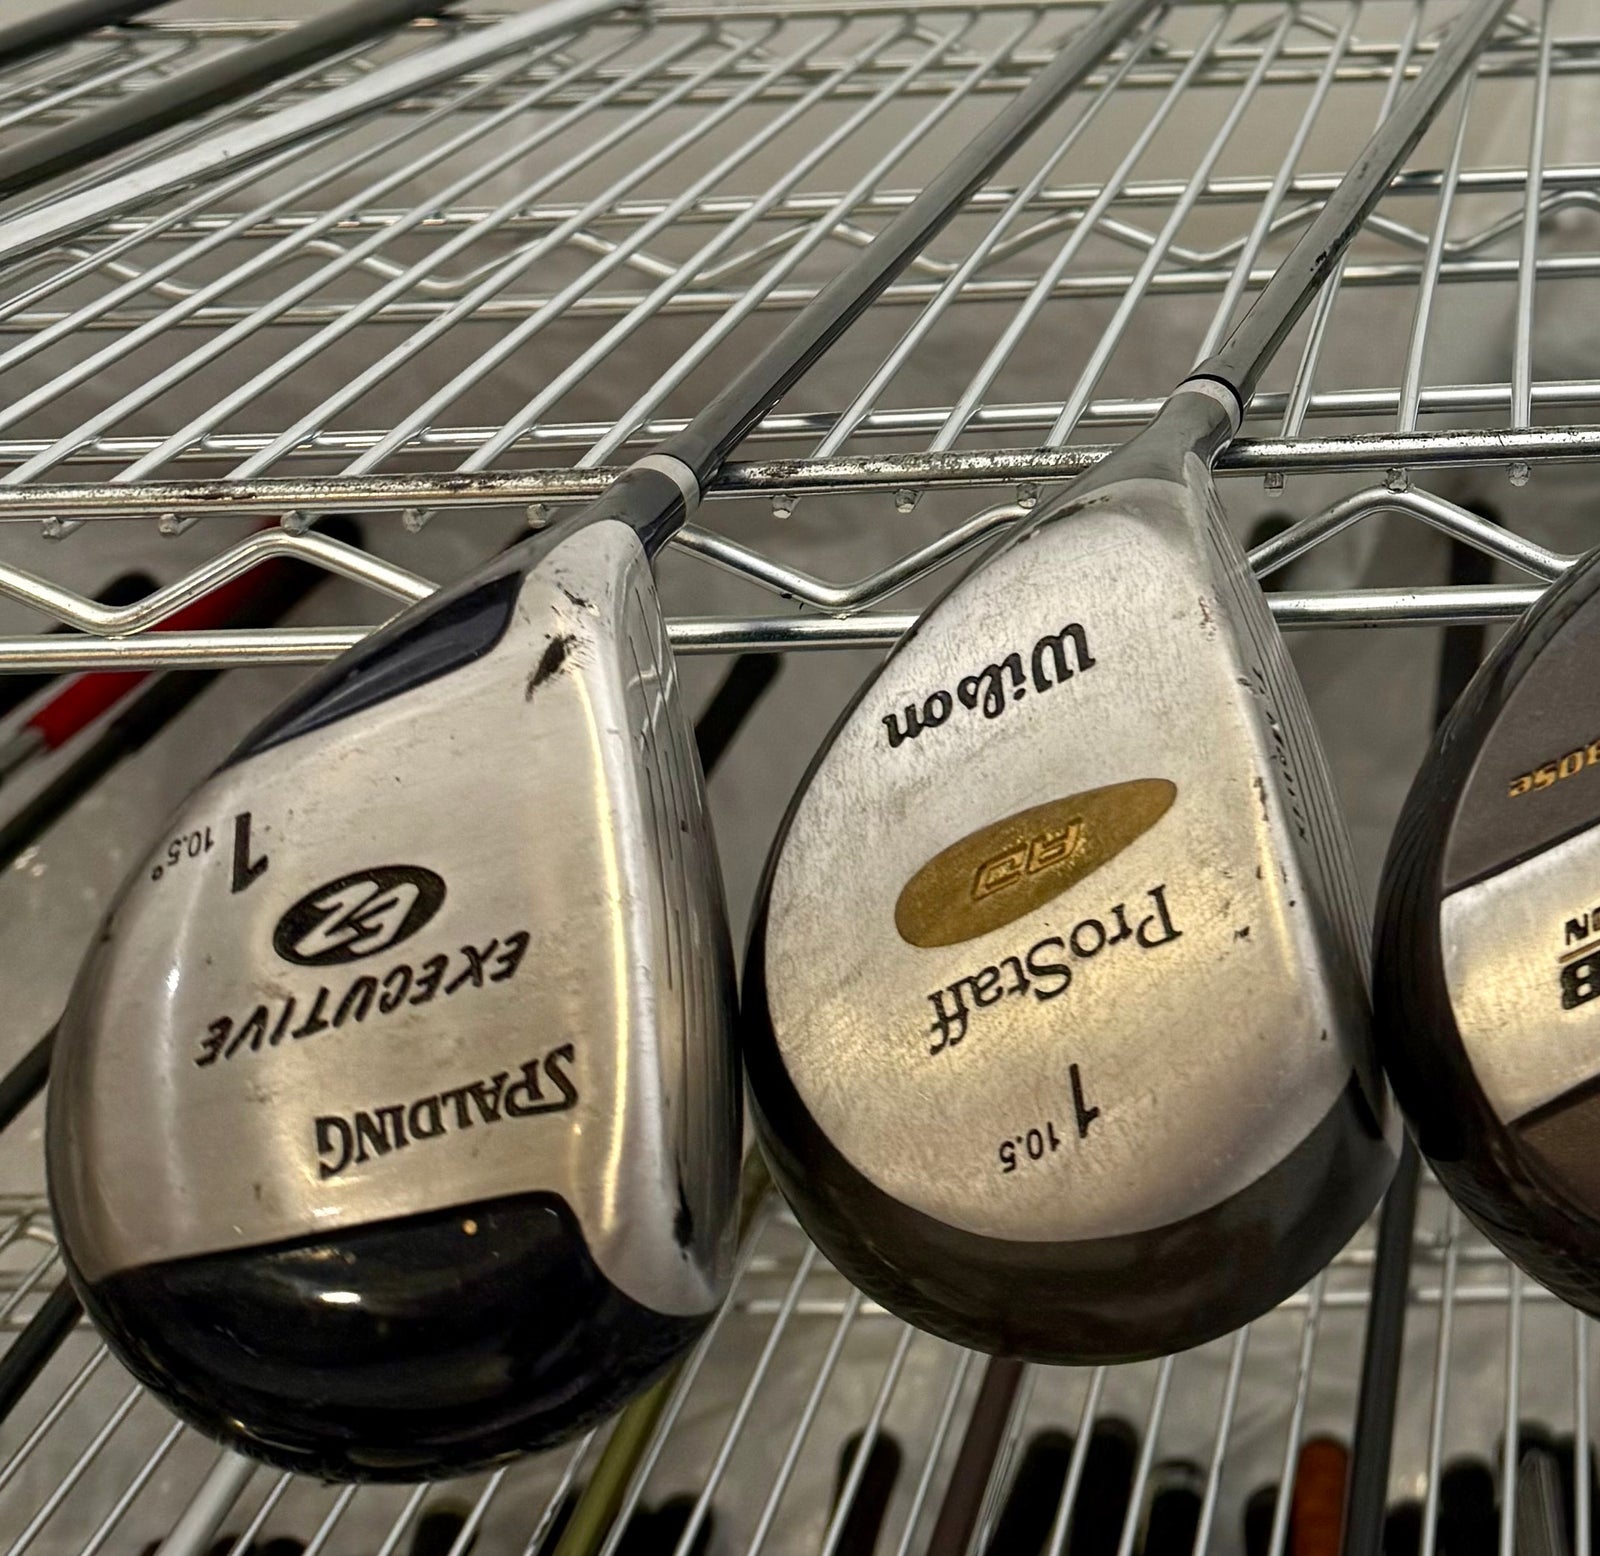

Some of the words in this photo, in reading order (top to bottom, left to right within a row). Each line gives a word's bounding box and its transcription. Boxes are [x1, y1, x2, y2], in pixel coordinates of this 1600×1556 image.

[882, 622, 1096, 749] Wilson
[230, 811, 270, 894] 1
[195, 930, 531, 1068] EXECUTIVE
[926, 883, 1185, 1057] ProStaff
[315, 1044, 580, 1181] SPALDING
[998, 1120, 1060, 1174] 10.5
[1069, 1063, 1100, 1139] 1
